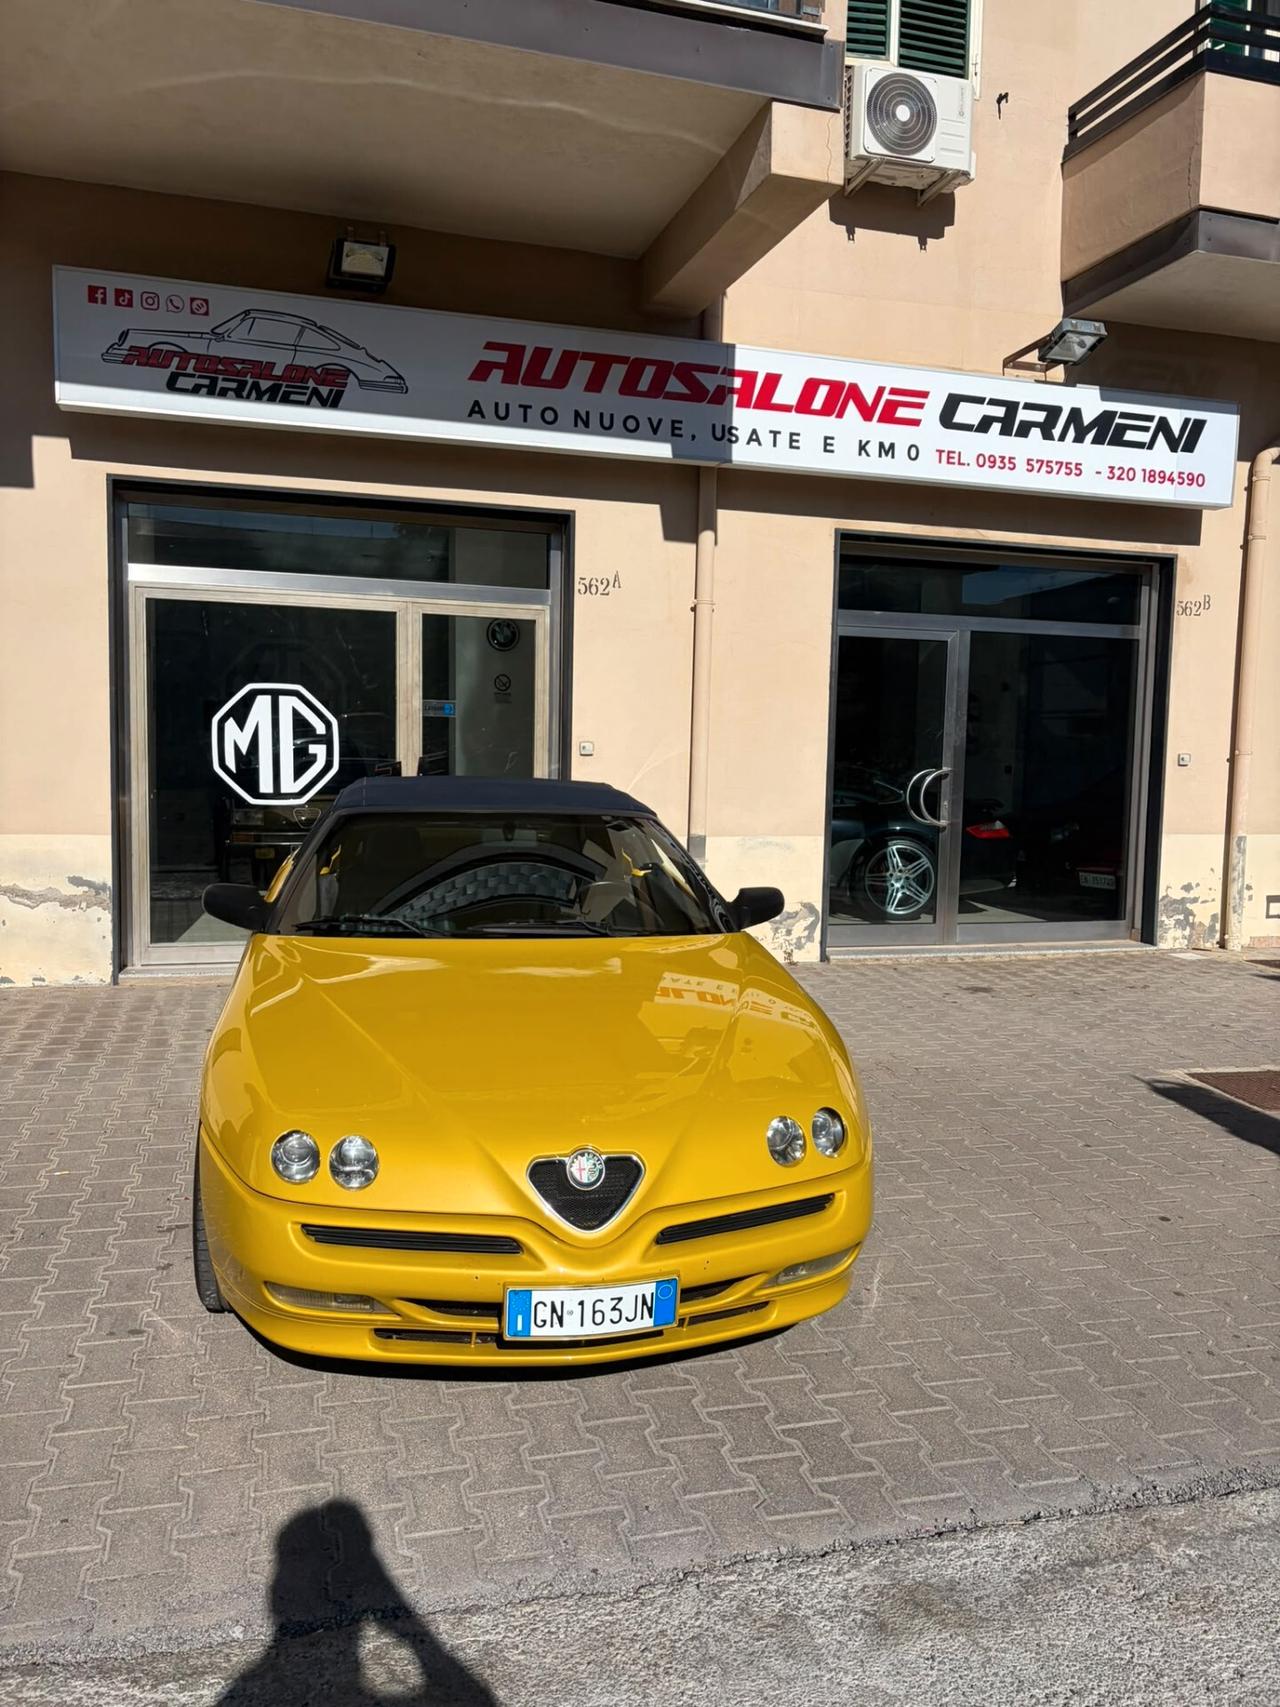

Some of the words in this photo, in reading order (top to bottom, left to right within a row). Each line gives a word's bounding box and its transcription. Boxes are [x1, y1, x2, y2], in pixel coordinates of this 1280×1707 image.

[122, 345, 349, 388] AUTOSALONE
[166, 371, 345, 408] CARMENI
[468, 340, 930, 427] AUTOSALONE
[938, 392, 1207, 454] CARMENI
[467, 399, 559, 426] AUTO
[573, 409, 697, 442] NUOVE,
[711, 423, 801, 450] USATE
[823, 436, 835, 453] E
[935, 449, 971, 466] TEL.
[976, 453, 1016, 471] 0935
[1026, 458, 1083, 477] 575755
[1106, 466, 1136, 482] 320
[1141, 469, 1206, 488] 1894590
[224, 695, 327, 793] MG
